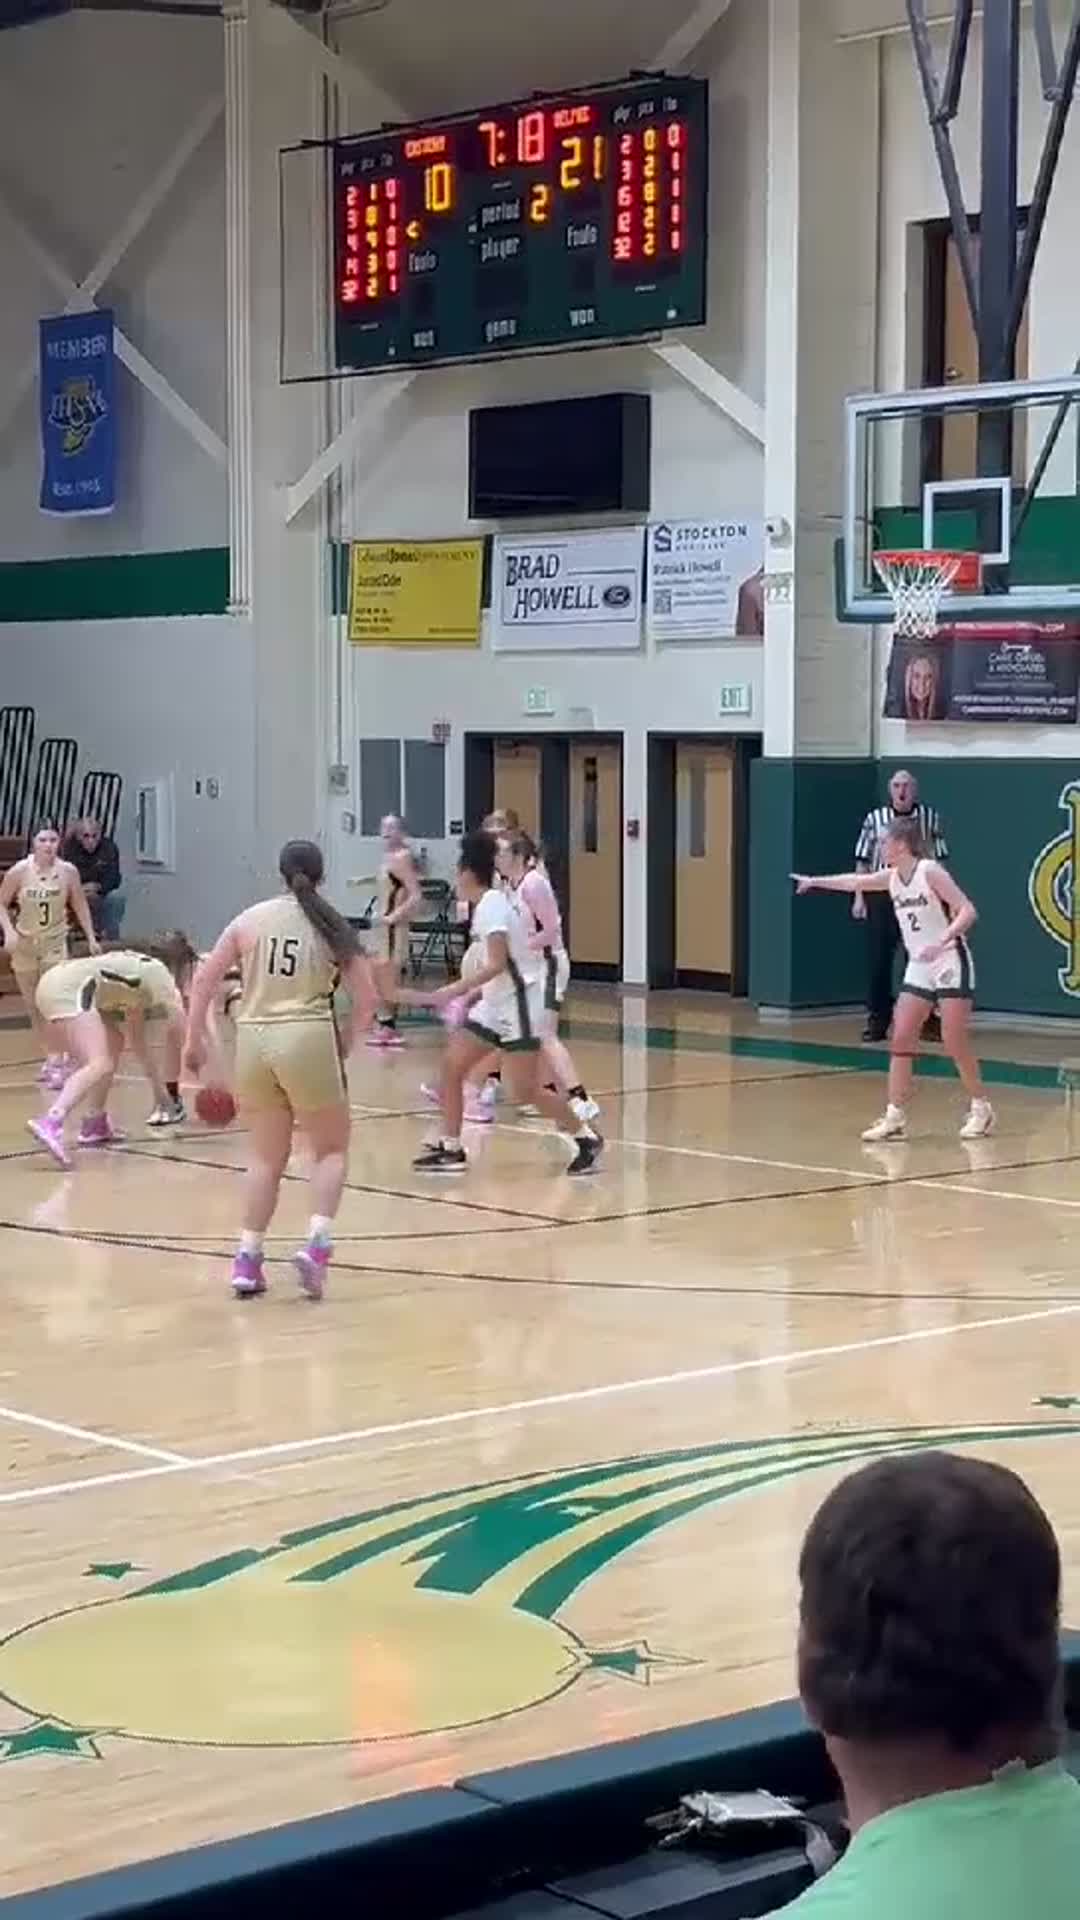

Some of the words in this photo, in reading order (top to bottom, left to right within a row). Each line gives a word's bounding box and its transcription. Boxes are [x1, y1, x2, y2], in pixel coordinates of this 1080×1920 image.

[478, 112, 544, 167] 7:18
[621, 134, 632, 154] 2
[643, 129, 655, 151] 0
[667, 123, 680, 147] 0
[561, 135, 604, 189] 21
[622, 160, 632, 181] 3
[644, 156, 654, 176] 2
[347, 186, 358, 206] 2
[425, 163, 450, 212] 10
[618, 186, 631, 206] 6
[347, 209, 358, 229] 3
[482, 198, 520, 229] period
[530, 184, 548, 222] 2
[47, 334, 107, 360] MEMBER
[676, 525, 748, 541] STOCKTON
[506, 553, 560, 586] BRAD
[513, 585, 599, 618] HOWELL
[721, 686, 744, 708] EXIT
[39, 902, 49, 926] 3
[907, 912, 921, 931] 2
[268, 937, 299, 977] 15
